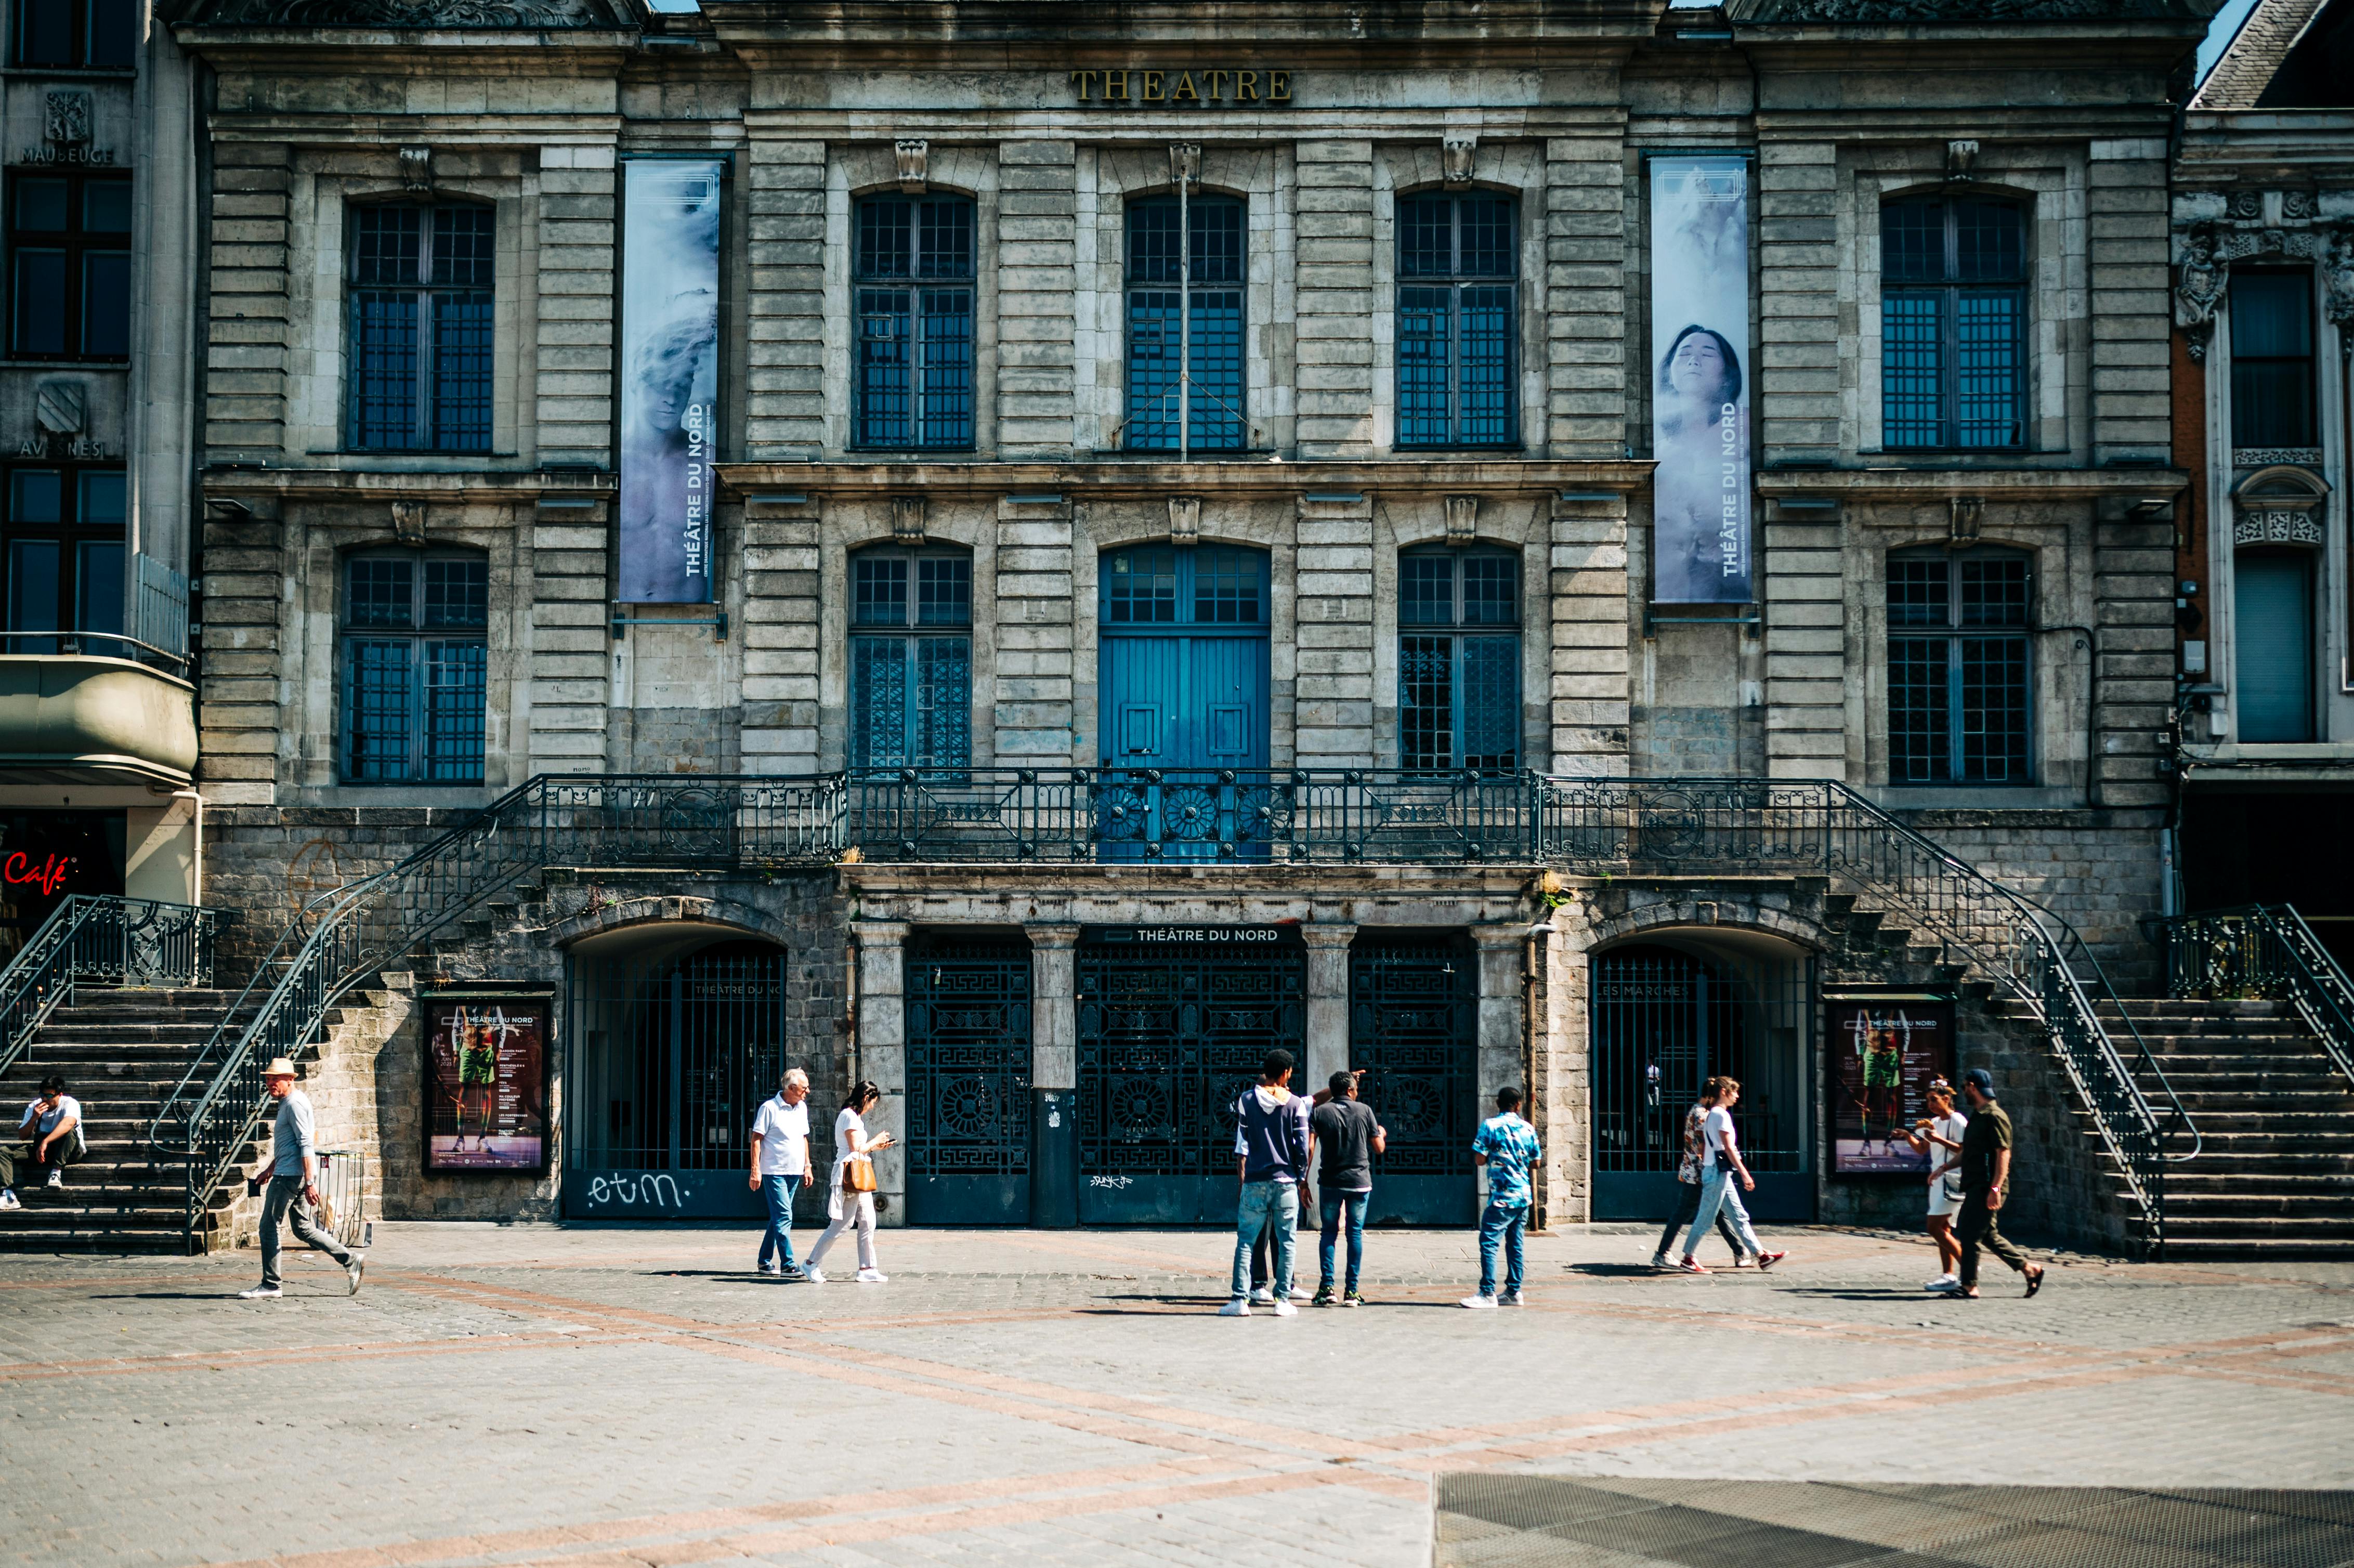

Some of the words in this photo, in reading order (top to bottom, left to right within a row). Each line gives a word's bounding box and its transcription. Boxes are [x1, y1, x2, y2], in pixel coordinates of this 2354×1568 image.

[1071, 70, 1292, 101] THEATRE
[21, 149, 114, 163] MAUBEUGE
[688, 403, 702, 457] NORD
[1721, 402, 1736, 456] NORD
[688, 463, 702, 489] DU
[1722, 462, 1736, 488] DU
[683, 495, 701, 577] THÉÂTRE
[1719, 494, 1737, 577] THÉÂTRE
[5, 852, 68, 895] Café
[1138, 927, 1204, 941] THÉÂTRE
[1209, 930, 1230, 941] DU
[1235, 930, 1278, 941] NORD
[696, 984, 743, 994] THÉÂTRE
[748, 986, 763, 994] DU
[466, 1015, 498, 1024] THÉÂTRE
